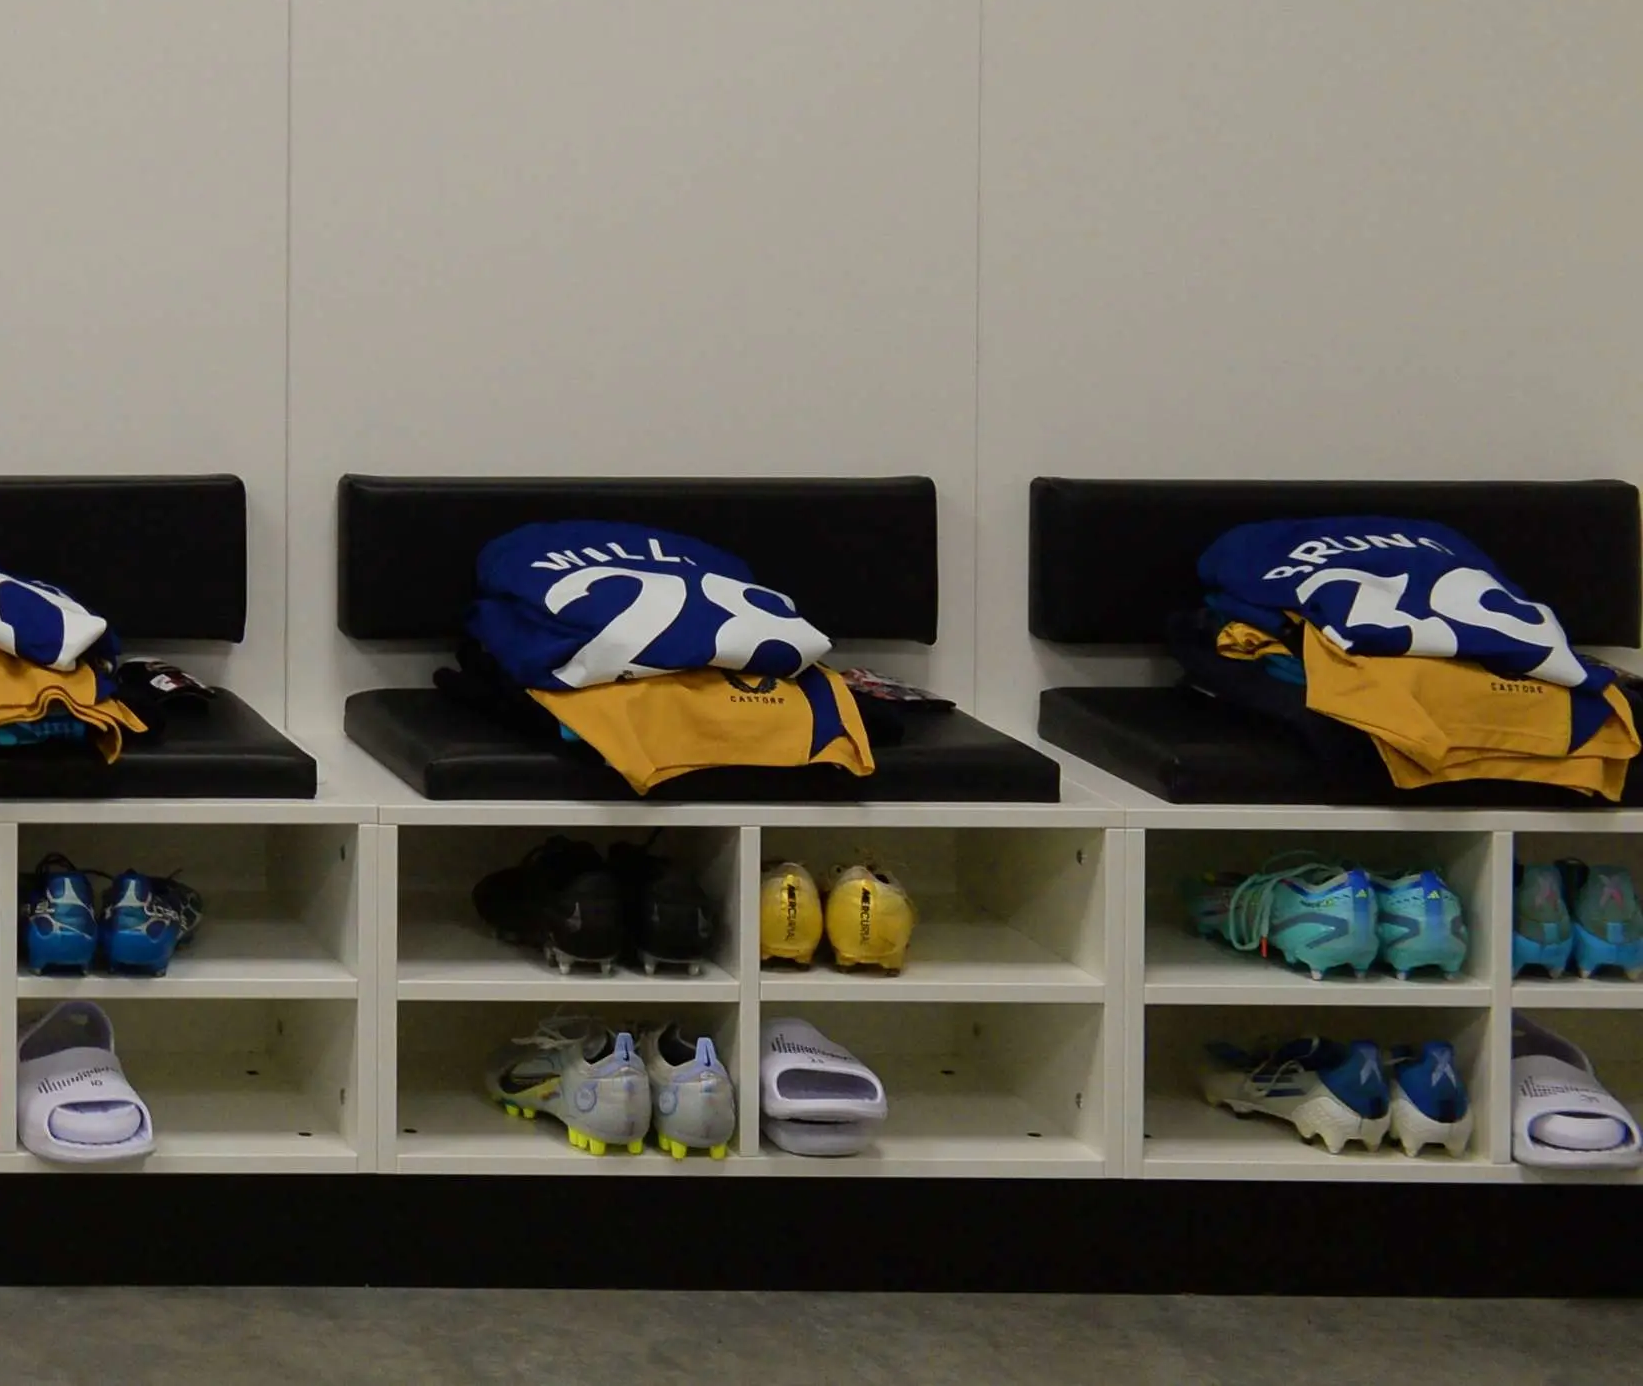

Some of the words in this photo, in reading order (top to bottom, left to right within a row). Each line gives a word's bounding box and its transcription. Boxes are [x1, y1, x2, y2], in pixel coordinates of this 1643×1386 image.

[530, 538, 698, 571] WILL
[544, 566, 834, 688] 28
[1295, 567, 1589, 688] 39
[729, 694, 786, 705] CASTORE
[1490, 681, 1544, 694] CASTORE
